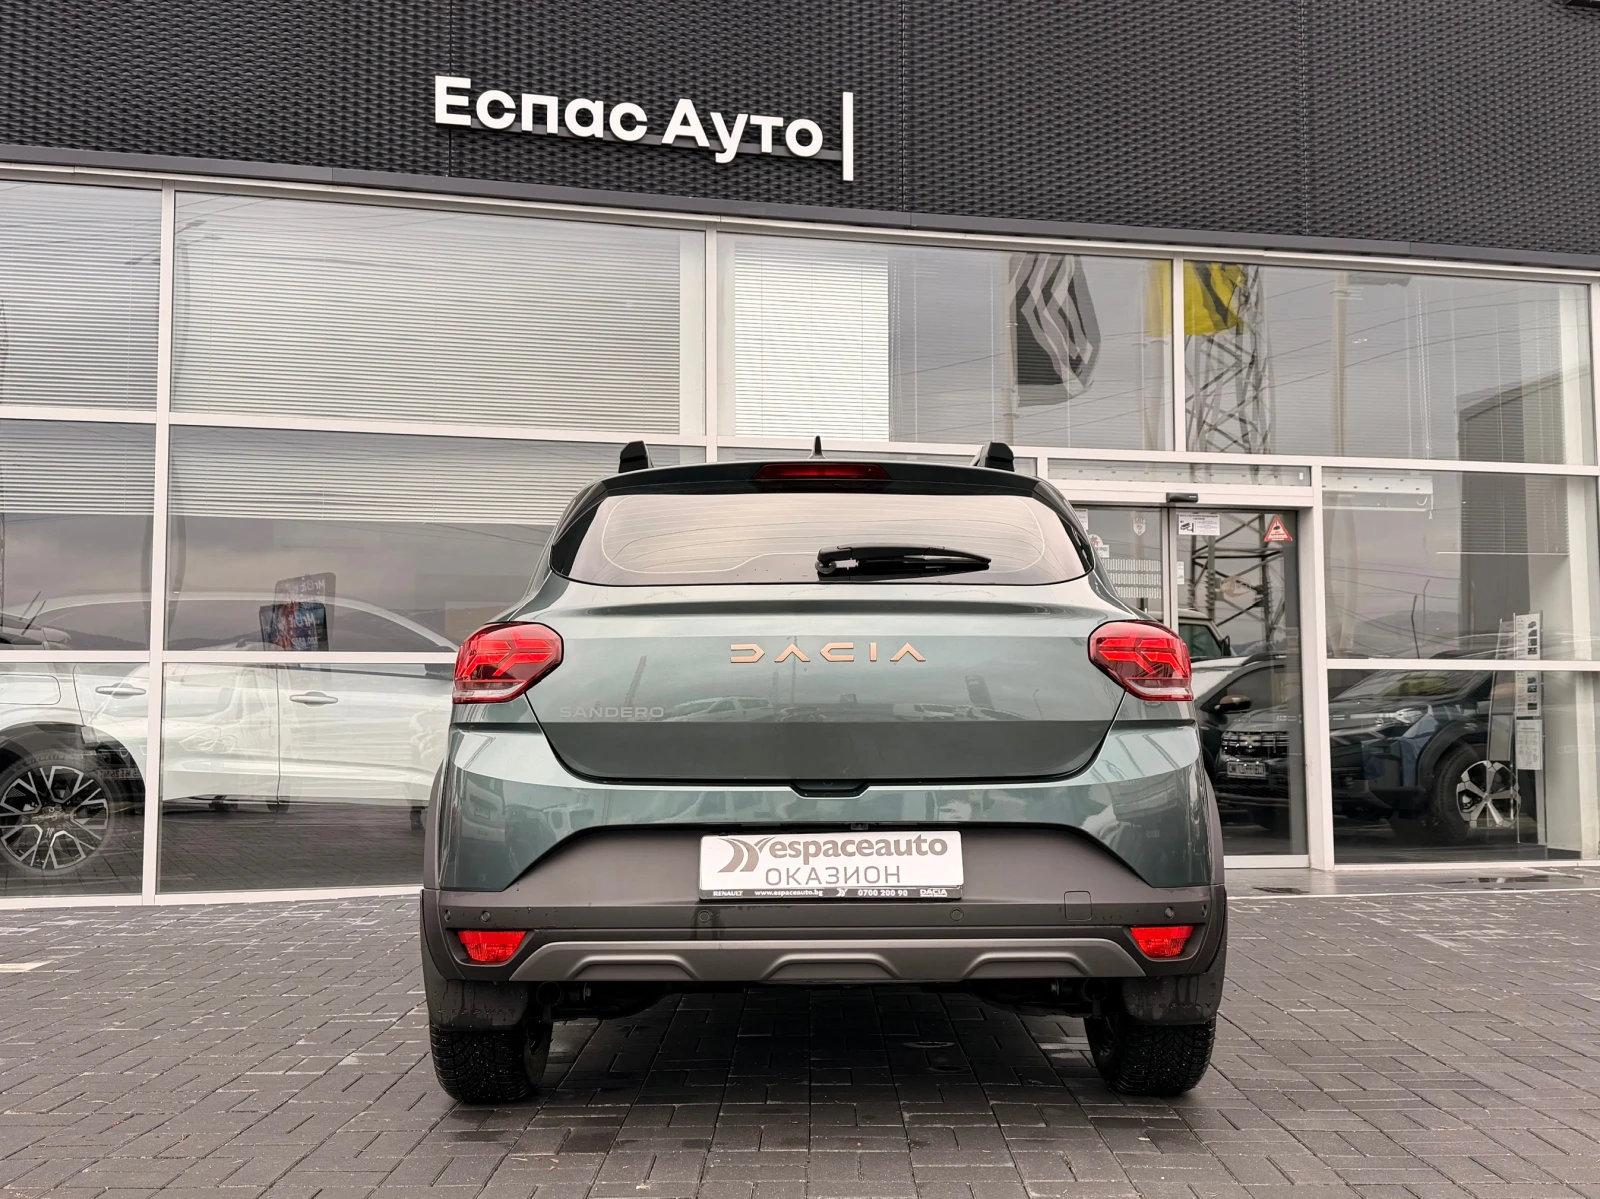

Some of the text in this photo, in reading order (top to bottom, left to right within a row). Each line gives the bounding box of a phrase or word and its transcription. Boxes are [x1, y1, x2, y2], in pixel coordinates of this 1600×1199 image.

[435, 75, 824, 164] Еспас Ауто
[730, 641, 927, 663] DACIA
[559, 706, 665, 719] SANDERO
[769, 833, 948, 865] espaceauto
[765, 866, 901, 886] ОКАЗИОН
[754, 888, 824, 897] www.espaceauto.bg
[857, 889, 908, 897] 0700 200 90
[919, 888, 948, 896] DACIA
